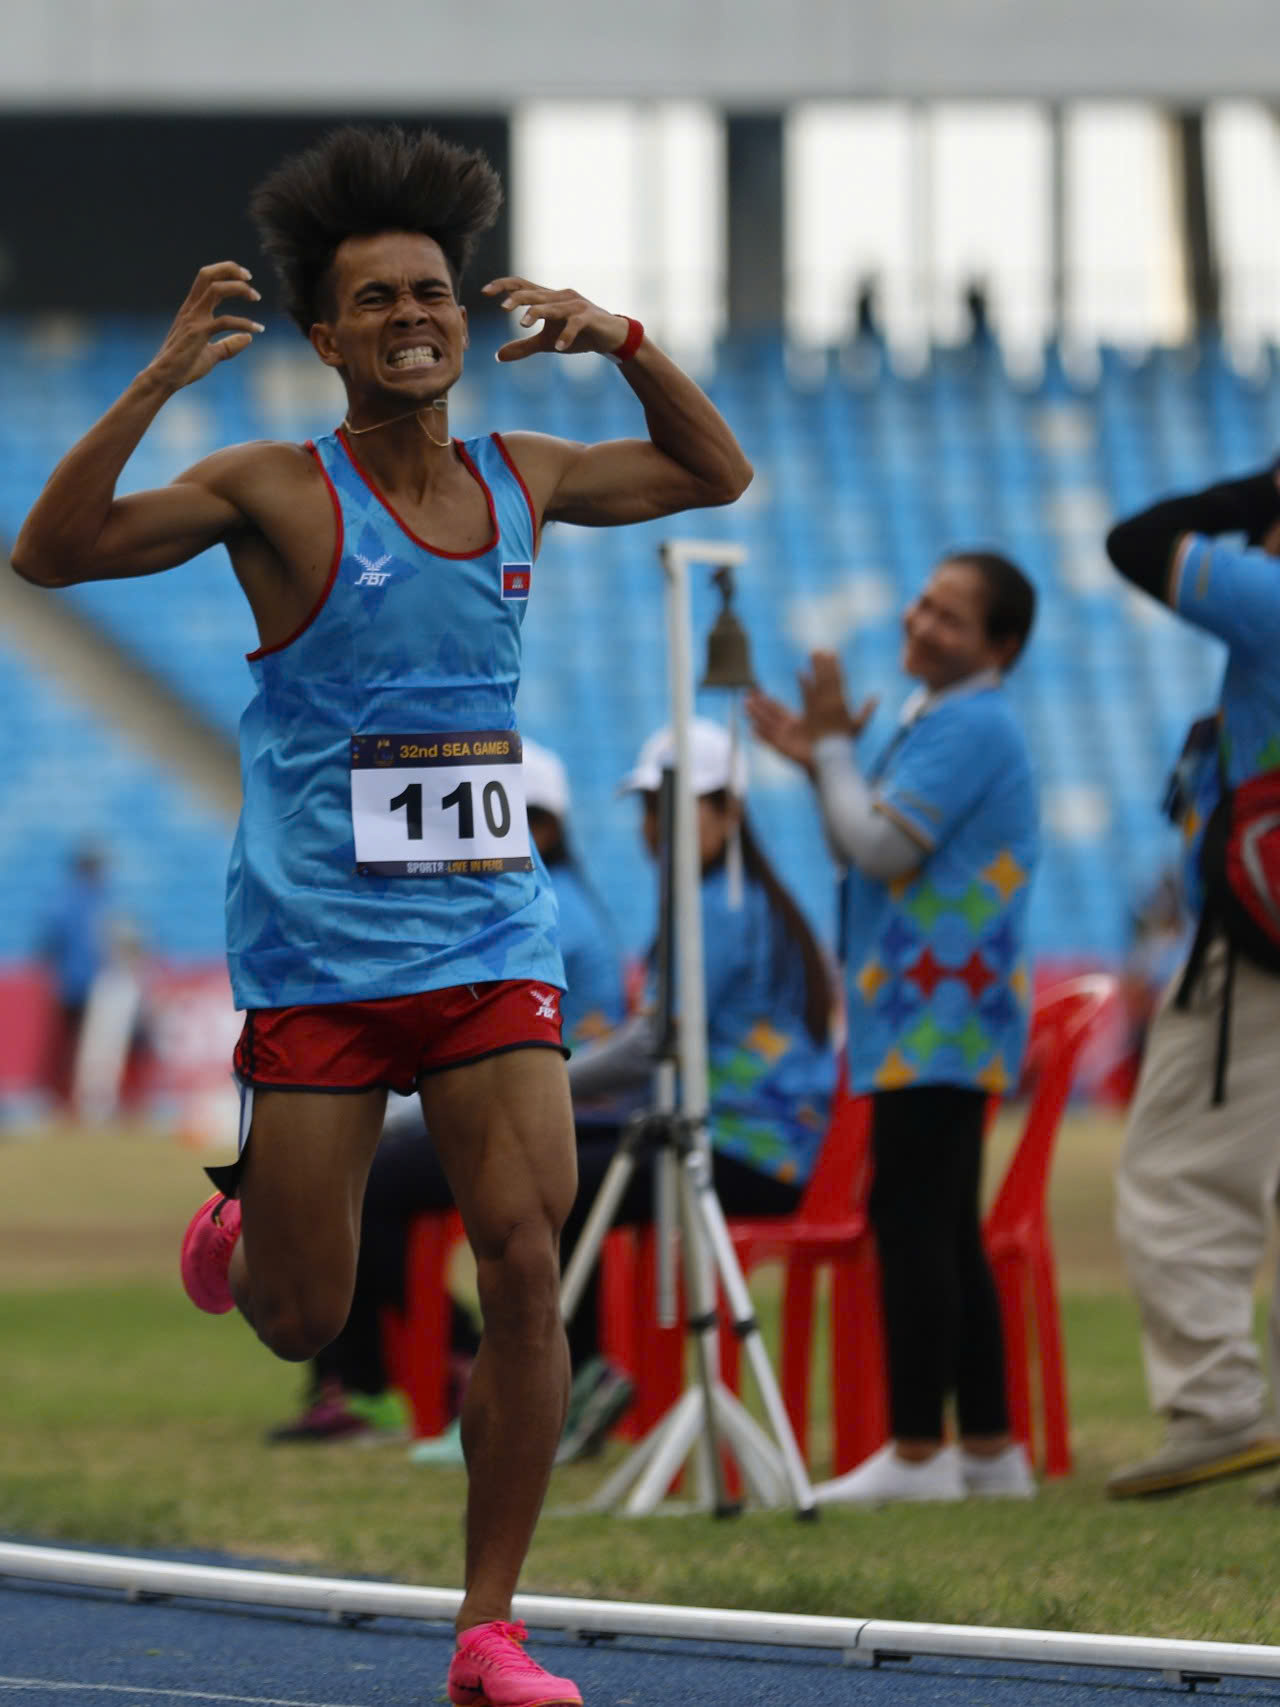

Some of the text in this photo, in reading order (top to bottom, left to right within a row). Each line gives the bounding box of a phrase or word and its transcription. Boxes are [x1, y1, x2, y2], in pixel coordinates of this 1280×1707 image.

[354, 572, 391, 587] FBT
[399, 740, 510, 759] 32nd SEA GAMES
[389, 779, 511, 841] 110
